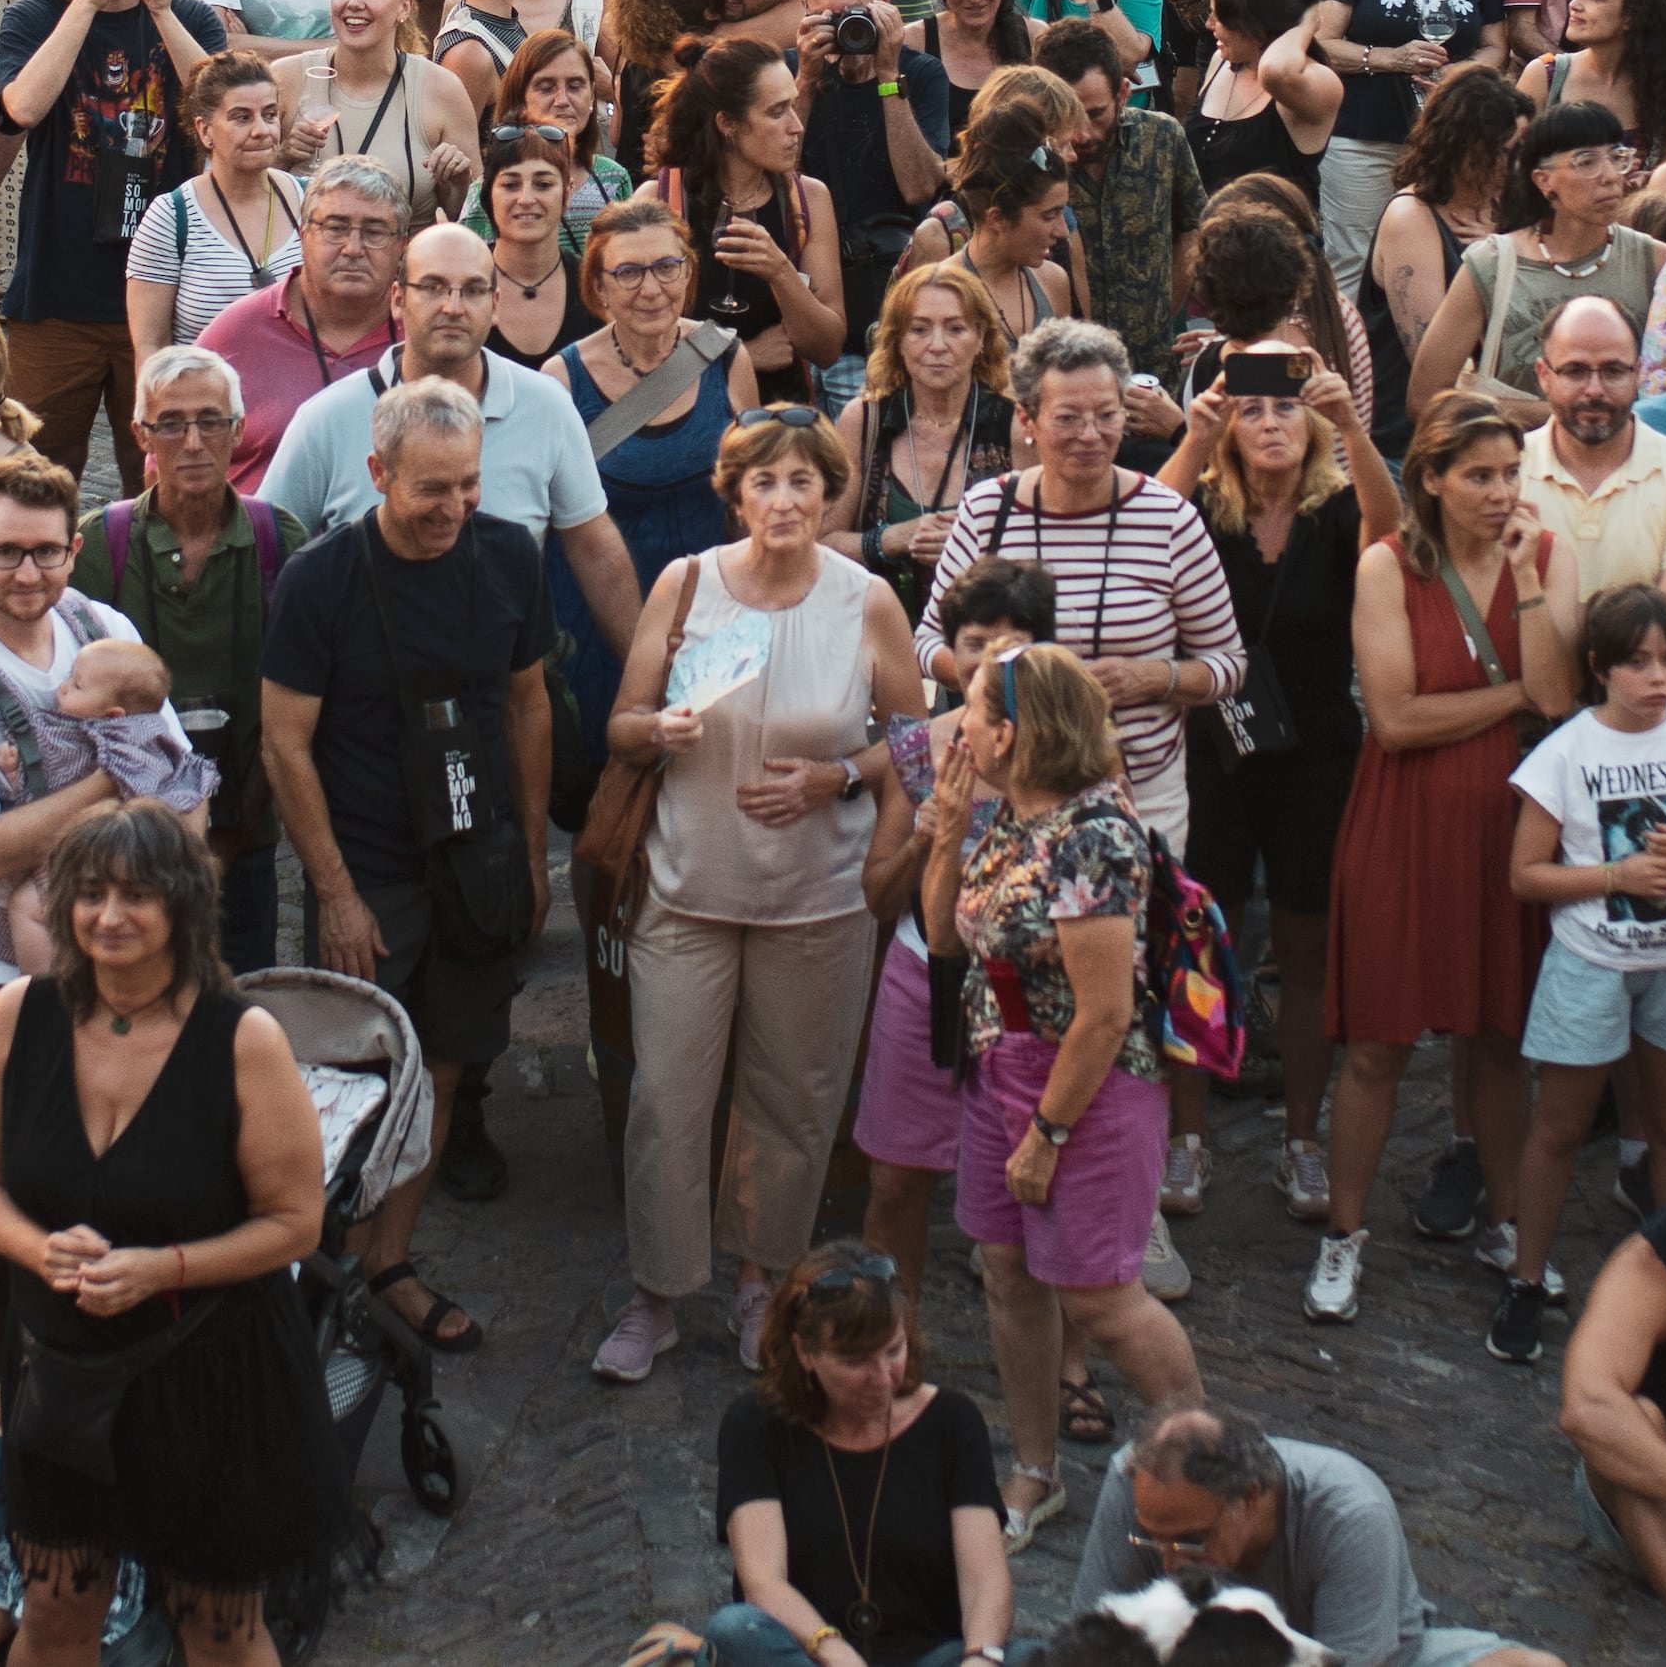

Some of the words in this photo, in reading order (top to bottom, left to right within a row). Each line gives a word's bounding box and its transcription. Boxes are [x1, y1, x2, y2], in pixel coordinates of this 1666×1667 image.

[125, 184, 141, 197] SO
[124, 197, 148, 211] MON
[123, 211, 137, 224] TA
[121, 224, 136, 238] NO
[446, 762, 465, 781] SO
[448, 776, 475, 798] MON
[450, 795, 469, 814] TA
[452, 811, 472, 832] NO
